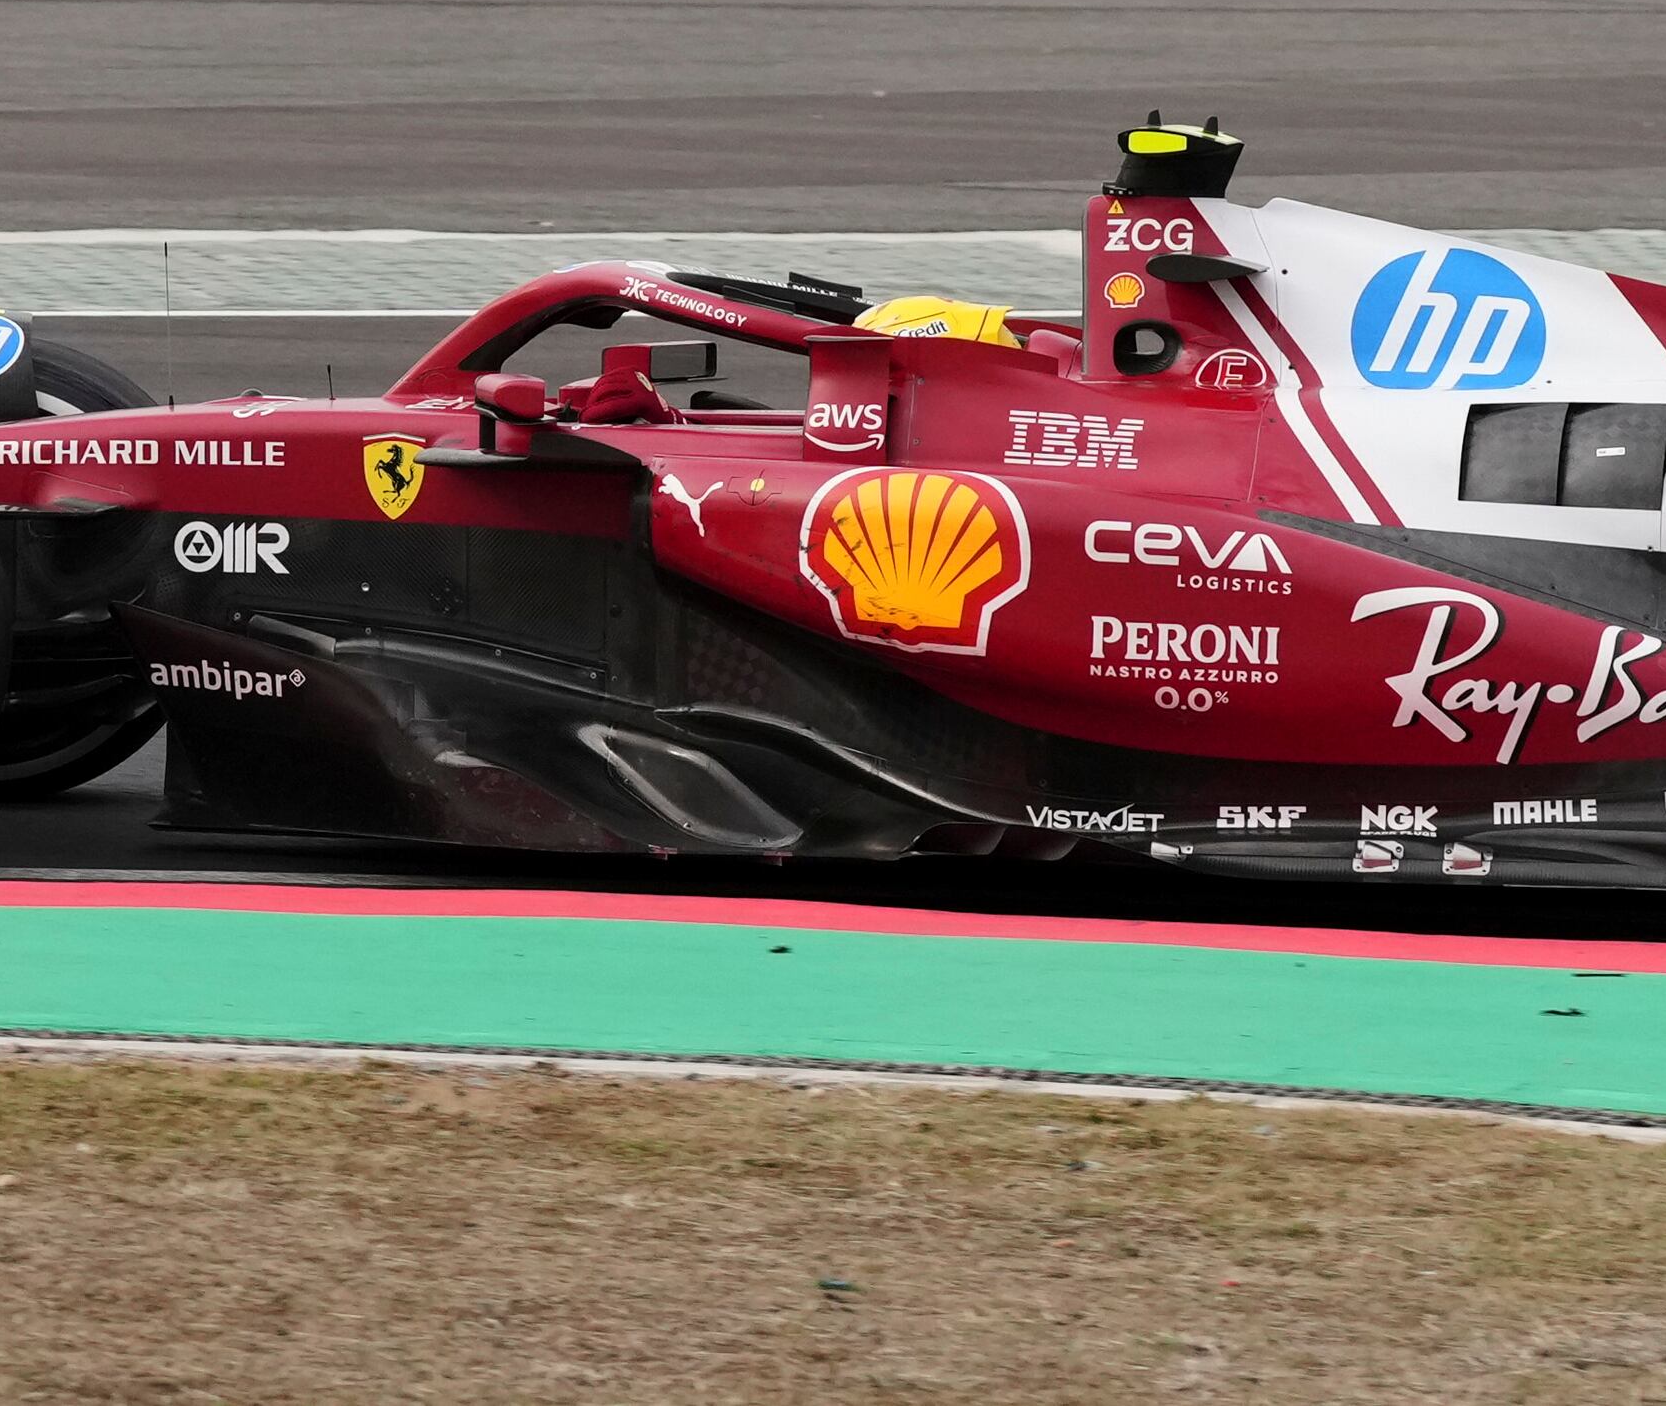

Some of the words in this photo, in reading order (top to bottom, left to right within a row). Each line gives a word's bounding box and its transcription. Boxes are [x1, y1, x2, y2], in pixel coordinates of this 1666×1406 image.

[654, 289, 748, 329] TECHNOLOGY
[1369, 249, 1531, 390] hp
[175, 441, 286, 466] MILLE
[1003, 410, 1145, 470] IBM
[1176, 575, 1294, 596] LOGISTICS
[1090, 614, 1281, 666] PERONI
[150, 659, 287, 700] ambipar
[1089, 665, 1173, 681] NASTRO
[1178, 669, 1280, 685] AZZURRO
[1154, 686, 1230, 713] 0.0%
[1216, 805, 1307, 829] SKF
[1360, 804, 1439, 832] NGK
[1493, 798, 1598, 825] MAHLE
